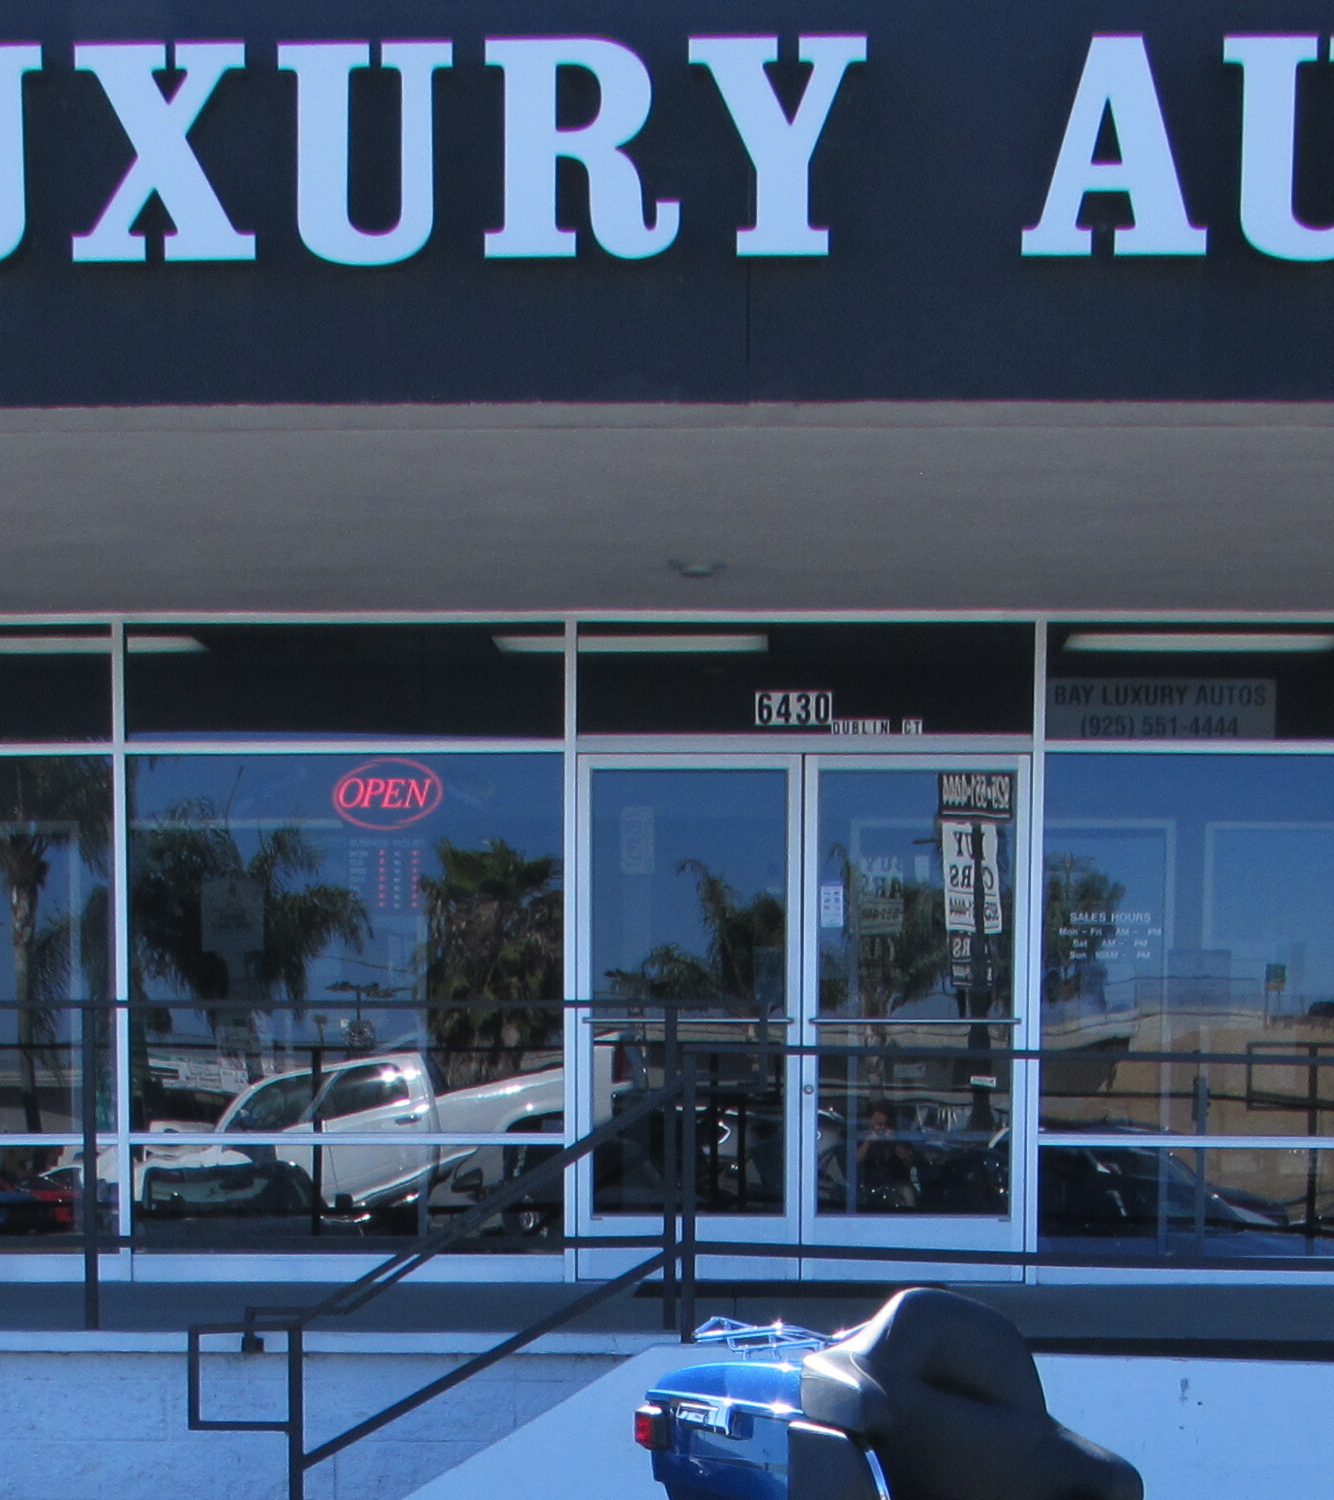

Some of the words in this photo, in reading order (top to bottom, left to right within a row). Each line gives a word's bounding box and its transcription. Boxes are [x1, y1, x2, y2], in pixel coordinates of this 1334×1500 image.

[1054, 684, 1095, 706] BAY
[1102, 684, 1188, 706] LUXURY
[1197, 684, 1267, 707] AUTOS
[756, 692, 831, 725] 6430
[832, 720, 889, 735] DUBLIN
[903, 720, 922, 735] CT
[1080, 714, 1134, 738] (925)
[1142, 714, 1239, 737] 551-4444
[338, 777, 433, 809] OPEN
[1069, 912, 1107, 922] SALES
[1111, 912, 1151, 922] HOURS
